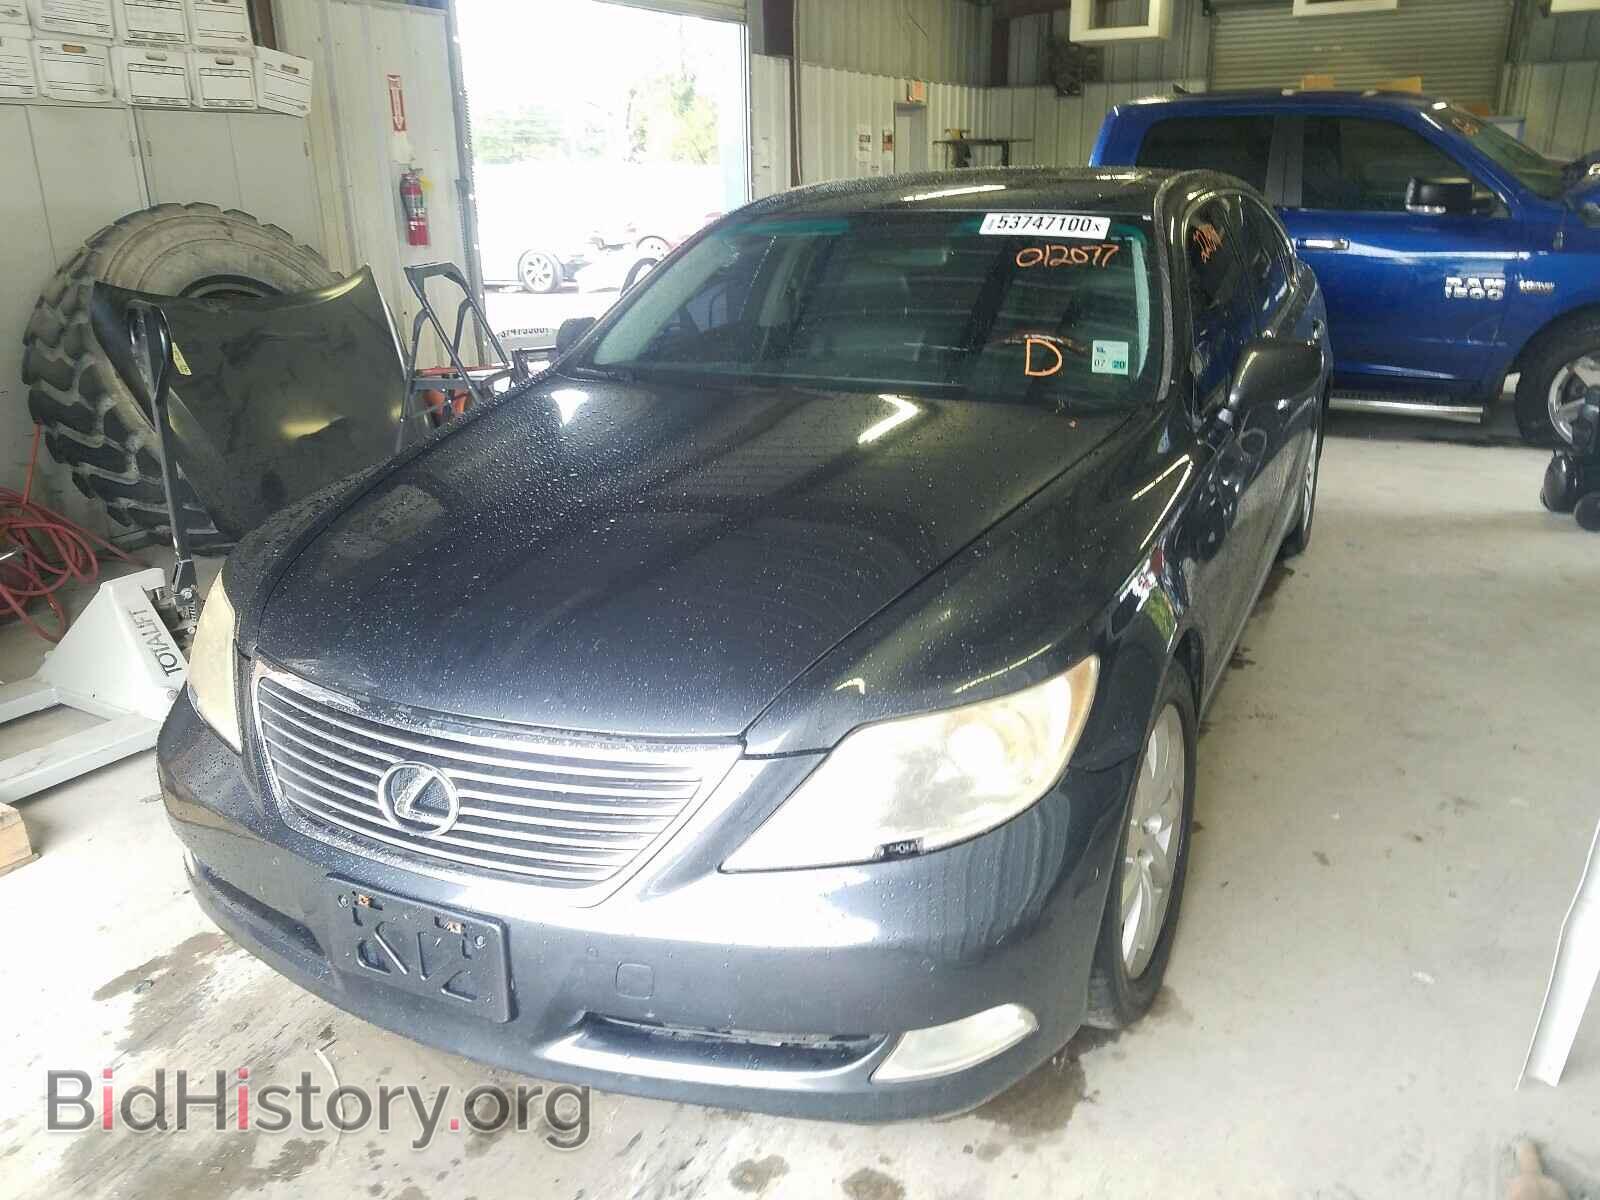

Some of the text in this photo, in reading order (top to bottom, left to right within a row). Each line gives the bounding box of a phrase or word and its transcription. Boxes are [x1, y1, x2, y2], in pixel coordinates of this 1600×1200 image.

[997, 214, 1092, 232] 53747100
[1015, 244, 1119, 268] 012077
[1024, 338, 1063, 376] D
[128, 609, 184, 678] TOTALIFT
